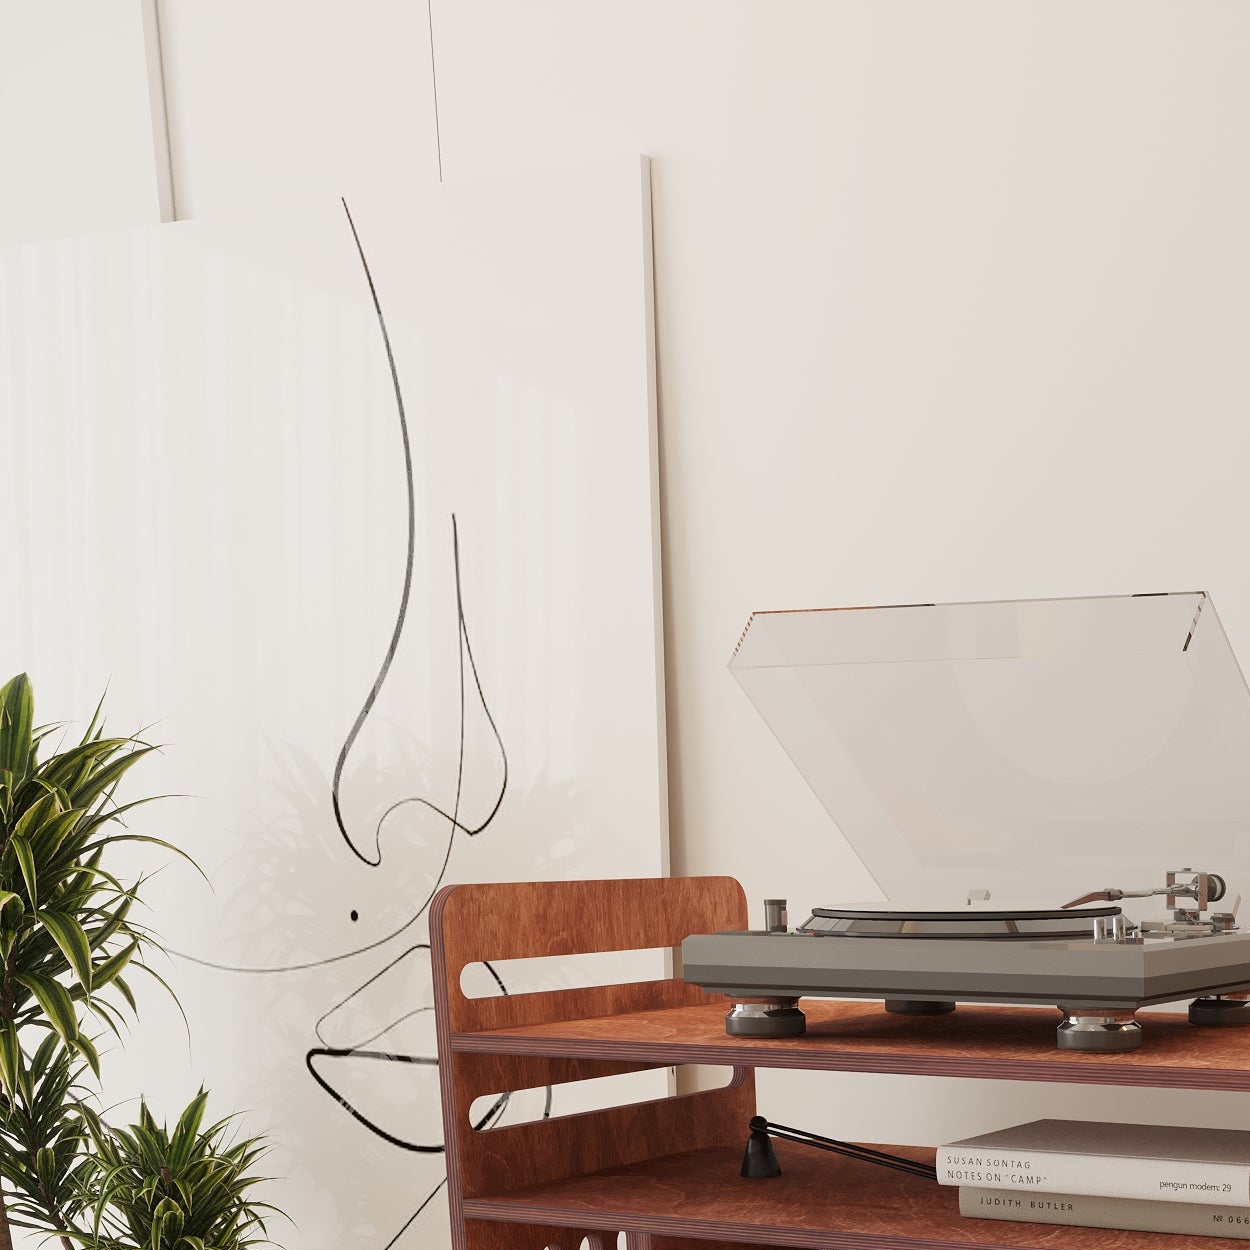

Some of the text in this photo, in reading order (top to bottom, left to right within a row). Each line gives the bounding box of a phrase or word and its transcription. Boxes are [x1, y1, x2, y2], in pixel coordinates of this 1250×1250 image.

[947, 1156, 1031, 1169] SUSAN SONTAG
[948, 1171, 981, 1180] NOTES
[986, 1173, 1000, 1182] ON
[1223, 1184, 1231, 1192] 29
[980, 1197, 1073, 1210] JUDITH BUTLER
